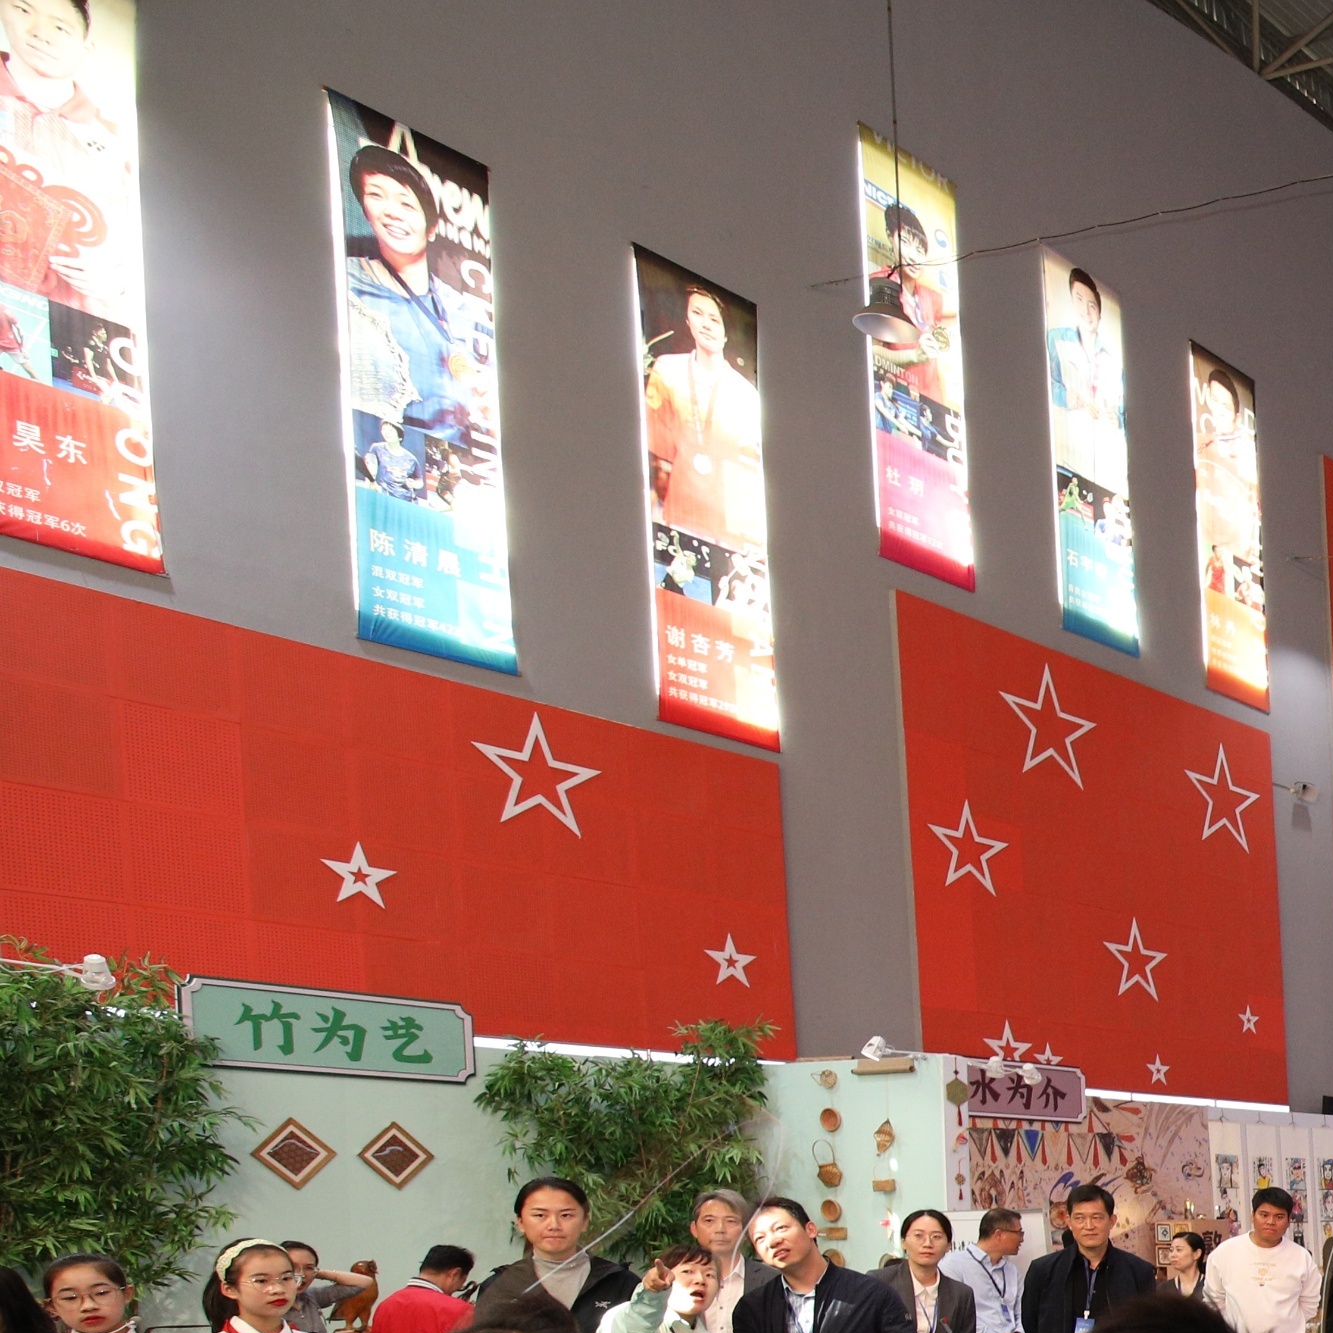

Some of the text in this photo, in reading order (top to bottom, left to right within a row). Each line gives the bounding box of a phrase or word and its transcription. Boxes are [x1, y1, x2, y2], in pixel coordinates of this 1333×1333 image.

[872, 353, 919, 386] DMINTON
[12, 419, 88, 466] 昊东
[0, 480, 41, 503] 冠军
[369, 528, 463, 578] 陈清晨
[371, 564, 425, 589] 混双冠军
[372, 585, 426, 609] 女双冠军
[665, 624, 736, 664] 谢杏芳
[235, 1000, 435, 1065] 竹为艺
[969, 1068, 1068, 1112] 水为介
